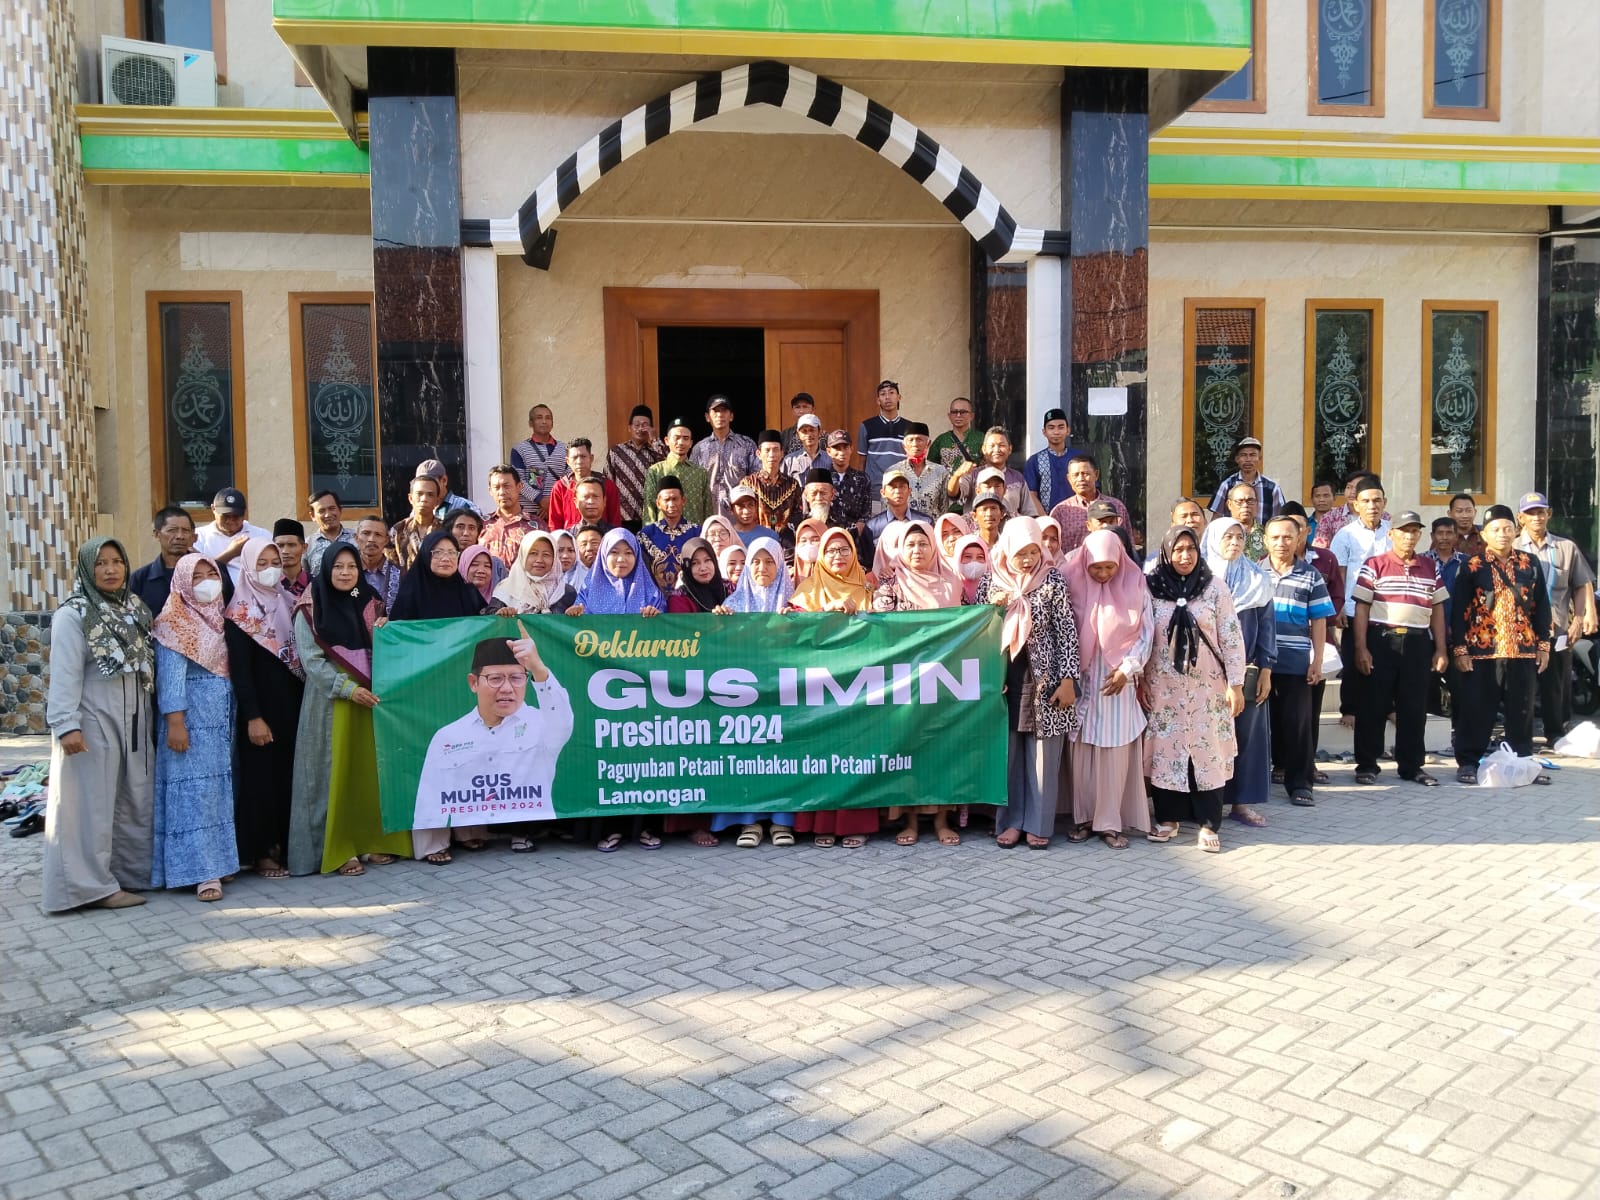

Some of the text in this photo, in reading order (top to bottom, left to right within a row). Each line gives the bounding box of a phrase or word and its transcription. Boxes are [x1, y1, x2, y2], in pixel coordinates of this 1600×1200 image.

[319, 386, 361, 426] الله
[1203, 385, 1239, 422] الله
[1437, 384, 1474, 421] الله
[574, 629, 701, 658] Deklarasi
[587, 658, 981, 711] GUS IMIN
[595, 714, 784, 749] Presiden 2024
[471, 773, 512, 788] GUS
[597, 753, 913, 783] Paguyuban Petani Tembakau dan Petani Tebu
[441, 785, 542, 805] MUHAIMIN
[441, 801, 543, 814] PRESIDEN 2024
[598, 787, 706, 807] Lamongan
